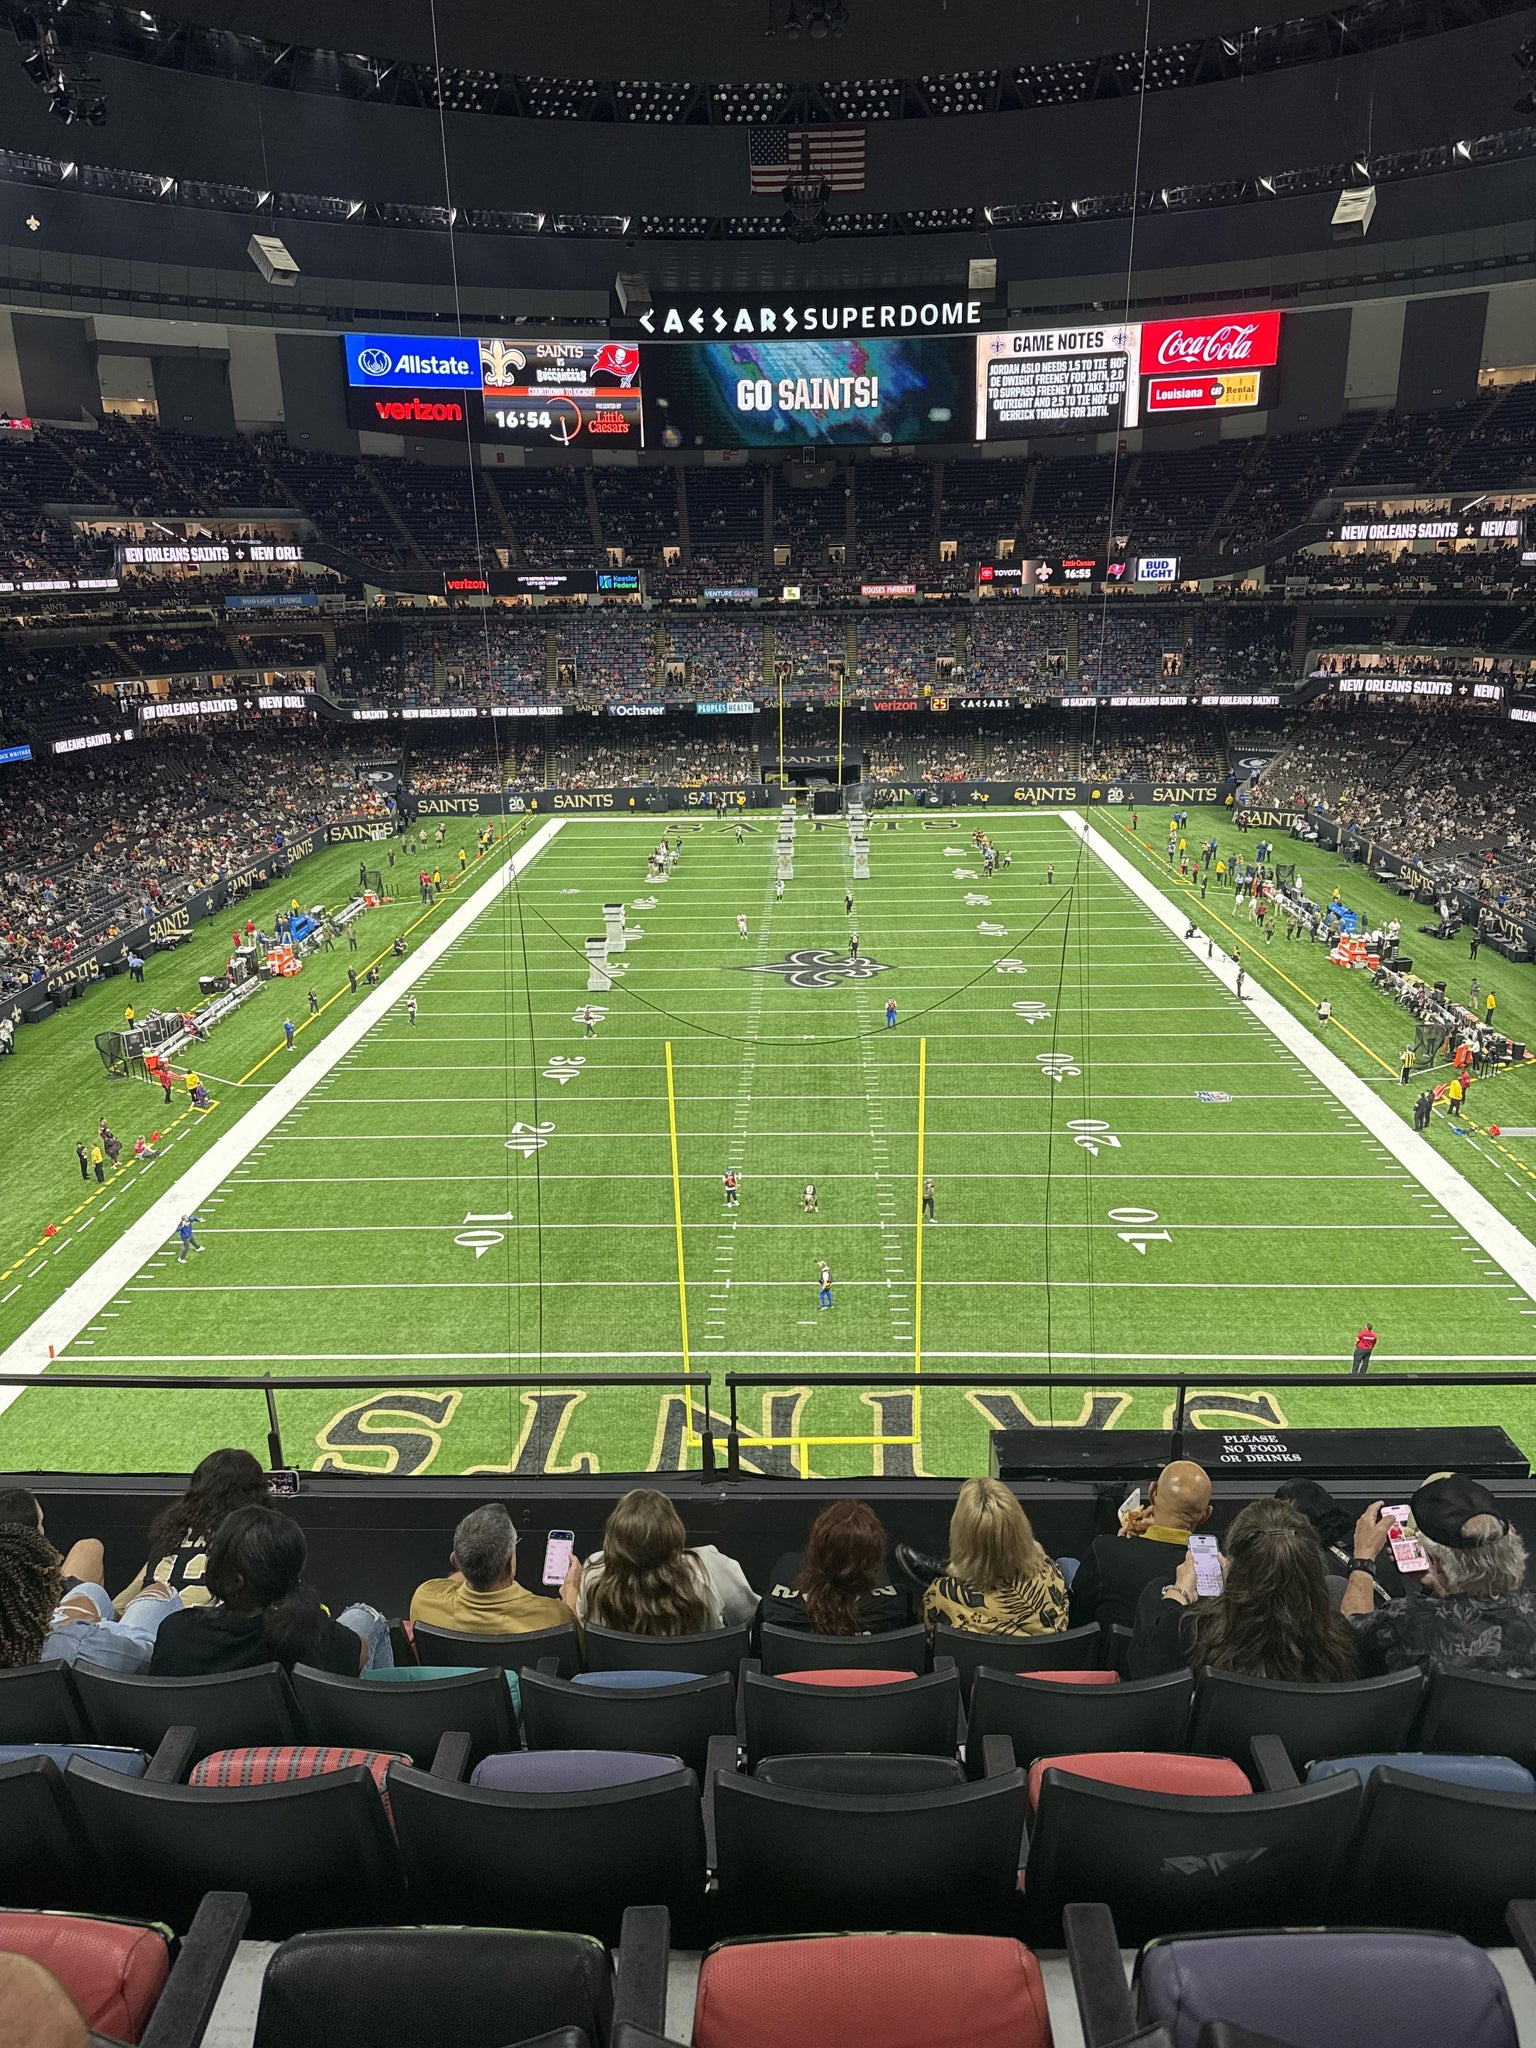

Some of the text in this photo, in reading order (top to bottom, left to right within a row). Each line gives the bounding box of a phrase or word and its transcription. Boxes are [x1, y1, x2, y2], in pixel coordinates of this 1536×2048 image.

[639, 301, 981, 334] CAESARS SUPERDOME
[1013, 331, 1104, 353] GAME NOTES
[1157, 323, 1260, 364] Coca-Cola
[536, 344, 584, 358] SAINTS
[395, 354, 470, 375] Allstate
[989, 357, 1127, 376] JORDAN ASLO NEEDS 1.5 TO TIE HOF
[536, 370, 587, 383] BUCCANEERS
[990, 369, 1124, 387] DE DWIGHT FREENEY FOR 19TH, 2.0
[528, 387, 596, 396] COUNTDOWN TO KICKOFF
[737, 376, 879, 412] GO SAINTS!
[989, 381, 1126, 399] TO SURPASS FREENEY TO TAKE 19TH
[1156, 385, 1255, 401] Louisiana CAT Rental
[375, 398, 462, 421] verizon
[993, 393, 1120, 411] OUTRIGHT AND 2.5 TO TIE HOF LB
[495, 411, 552, 428] 16:54
[595, 411, 624, 423] Little
[1000, 405, 1110, 421] DERRICK THOMAS FOR 18TH.
[588, 421, 629, 434] Caesars
[1341, 520, 1505, 540] NEW ORLEANS SAINTS NEW
[144, 546, 190, 562] ORLEANS
[190, 546, 230, 562] SAINTS
[250, 546, 275, 561] NEW
[994, 568, 1022, 577] TOYOTA
[1146, 560, 1169, 570] BUD
[1064, 568, 1092, 579] 16:55
[1140, 569, 1173, 579] LIGHT
[447, 579, 487, 590] verizon
[862, 584, 915, 595] ROUSES MARKETS
[704, 588, 758, 598] VENTURE GLOBAL
[1339, 679, 1494, 698] NEW ORLEANS SAINTS NEW
[156, 696, 283, 718] ORLEANS SAINTS NEW
[698, 703, 753, 713] PEOPLES HEALTH
[873, 700, 918, 711] verizon
[933, 698, 947, 709] 25
[1019, 696, 1047, 704] SAINTS
[1070, 695, 1279, 707] SAINTS NEW ORLEANS SAINTS NEW ORLEANS SAINTS
[361, 706, 563, 719] SAINTS NEW ORLEANS SAINTS NEW ORLEANS SAINTS
[616, 705, 665, 716] Ochsner
[55, 738, 86, 754] ORLEANS
[86, 733, 112, 748] SAINTS
[776, 753, 846, 764] SAINTS
[554, 793, 614, 809] SAINTS
[1014, 787, 1076, 801] SAINTS
[1152, 787, 1217, 802] SAINTS
[417, 798, 480, 814] SAINTS
[330, 821, 393, 842] SAINTS
[287, 843, 314, 864] SAINTS
[148, 906, 190, 943] SAINTS
[992, 958, 1028, 973] 50
[571, 1004, 610, 1023] 40
[1012, 1001, 1052, 1020] 40
[542, 1056, 586, 1078] 30
[1036, 1053, 1082, 1076] 30
[504, 1121, 556, 1150] 20
[1066, 1119, 1122, 1148] 20
[454, 1211, 514, 1247] 10
[1107, 1207, 1173, 1243] 10
[1223, 1435, 1279, 1443] PLEASE
[1222, 1444, 1288, 1453] NO FOOD
[1220, 1454, 1302, 1463] OR DRINKS
